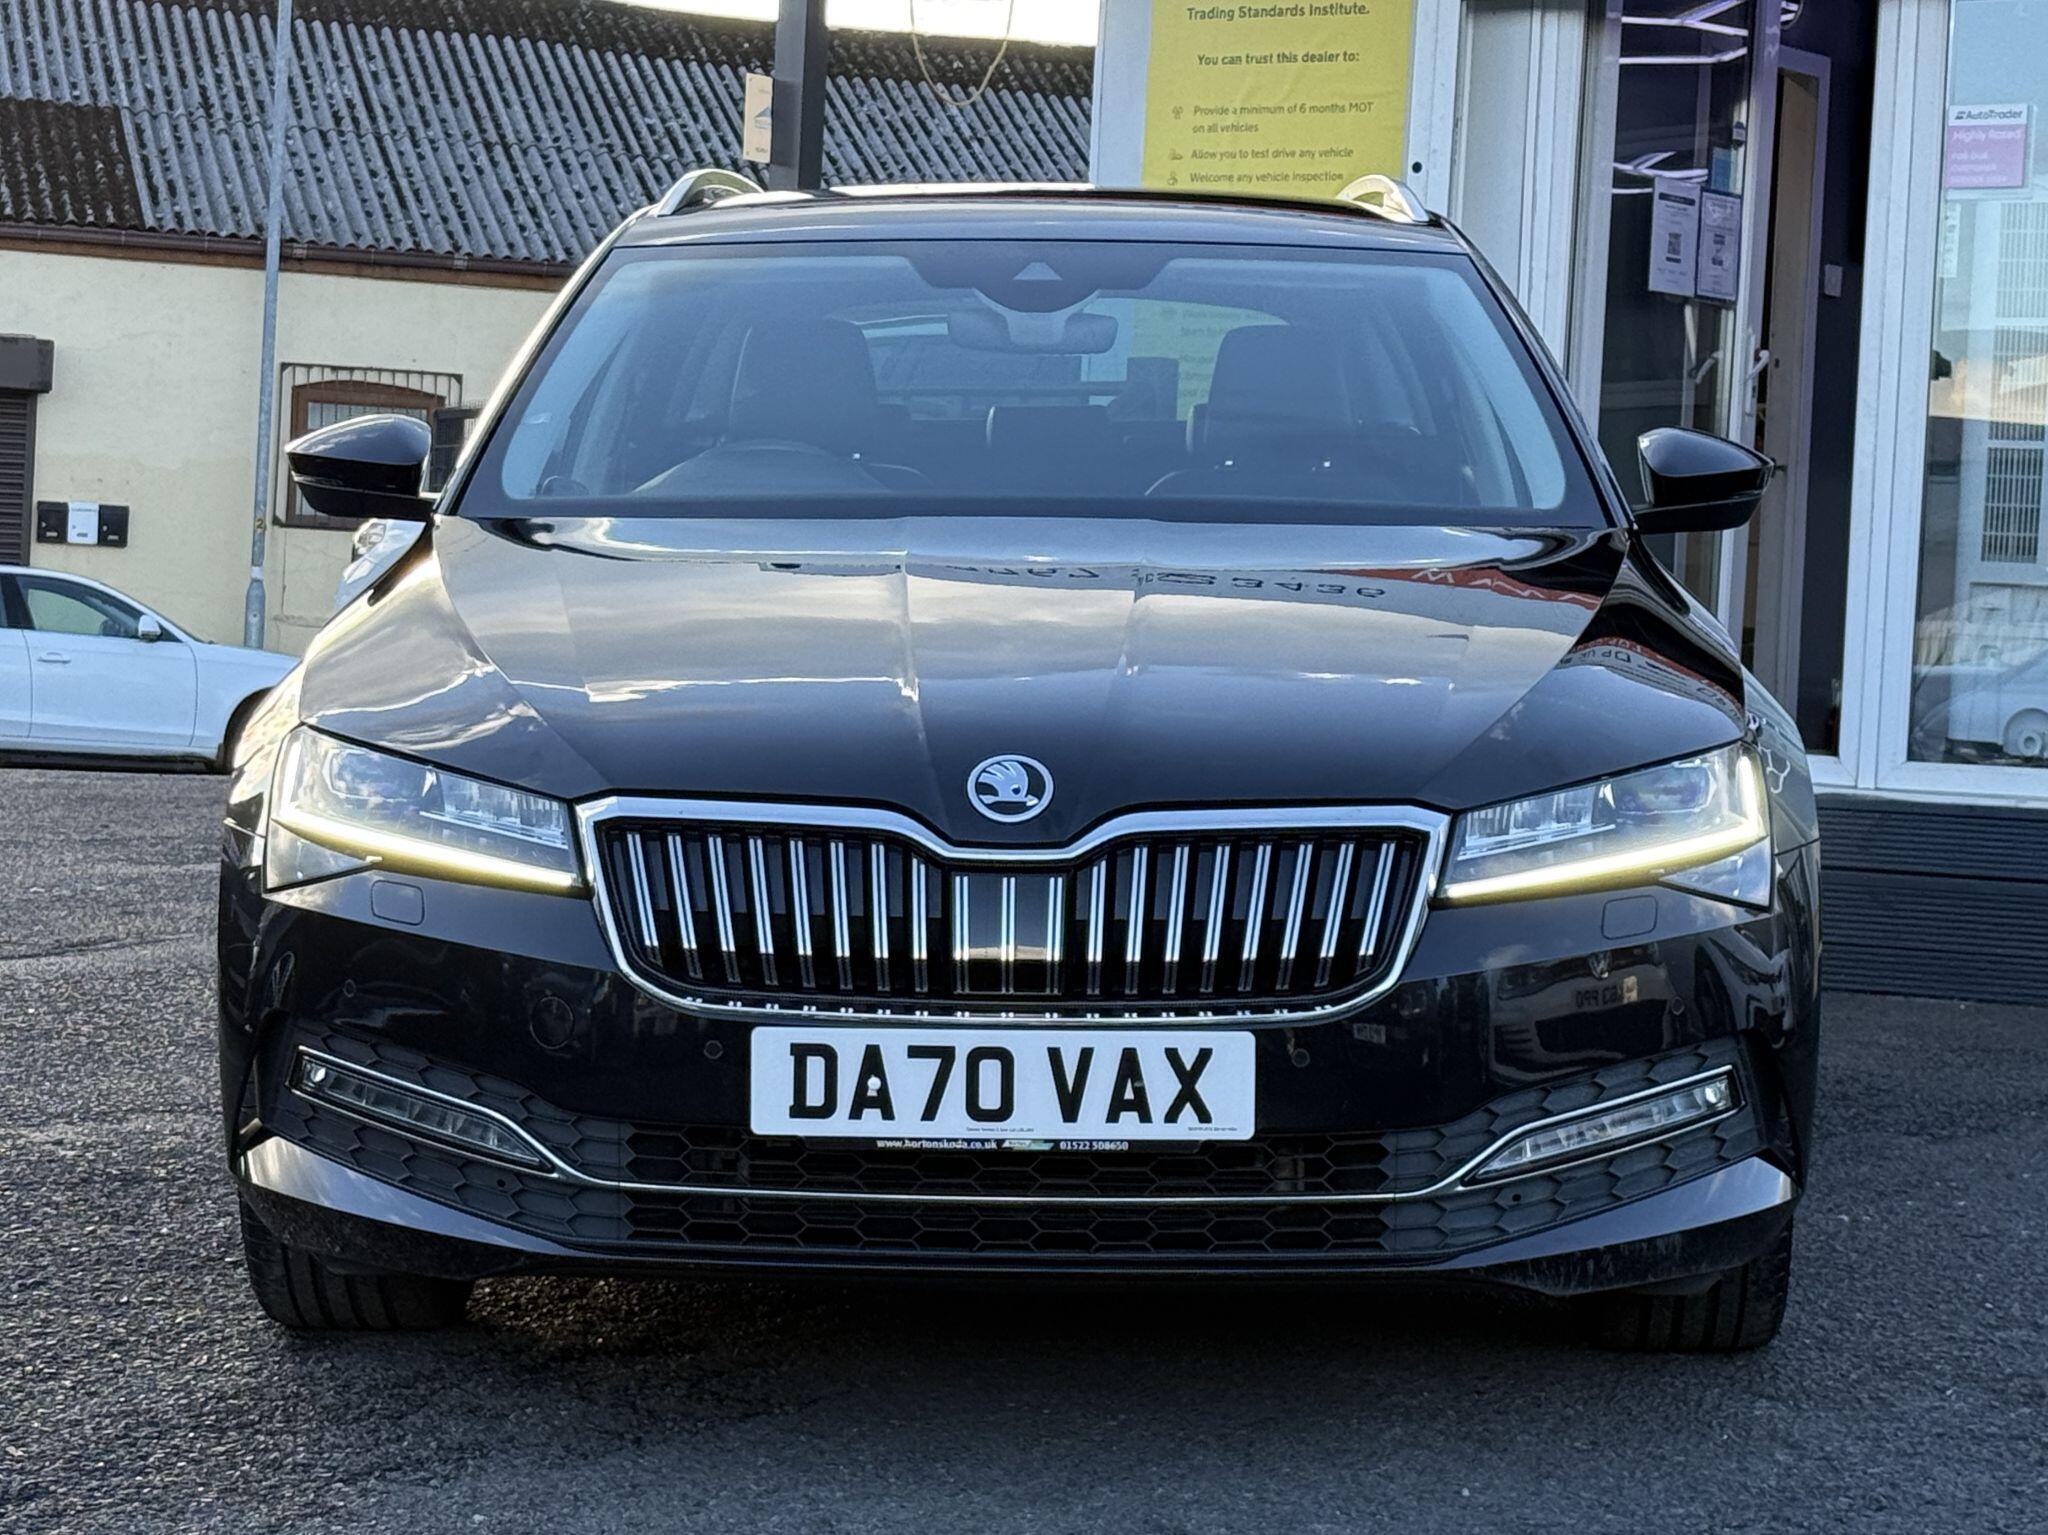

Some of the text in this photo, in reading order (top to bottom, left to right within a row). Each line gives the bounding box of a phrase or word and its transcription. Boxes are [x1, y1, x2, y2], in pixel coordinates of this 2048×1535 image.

[1187, 2, 1370, 21] Trading Standards Institute.
[1197, 51, 1360, 66] You can trust this dealer to:
[1193, 105, 1230, 116] Provide
[1239, 105, 1285, 115] minimum
[1287, 104, 1298, 114] of
[1299, 104, 1306, 114] 6
[1309, 103, 1346, 114] months
[1348, 102, 1374, 113] MOT
[1192, 122, 1259, 133] on all vehicles
[1190, 147, 1354, 161] Allow you to test drive any vehicle
[1189, 173, 1234, 183] Welcome
[1236, 173, 1254, 184] any
[1256, 171, 1290, 182] vehicle
[789, 1043, 1213, 1123] DA70 VAX
[877, 1139, 998, 1149] www.hortonskoda.co.uk
[1060, 1141, 1090, 1150] 01522
